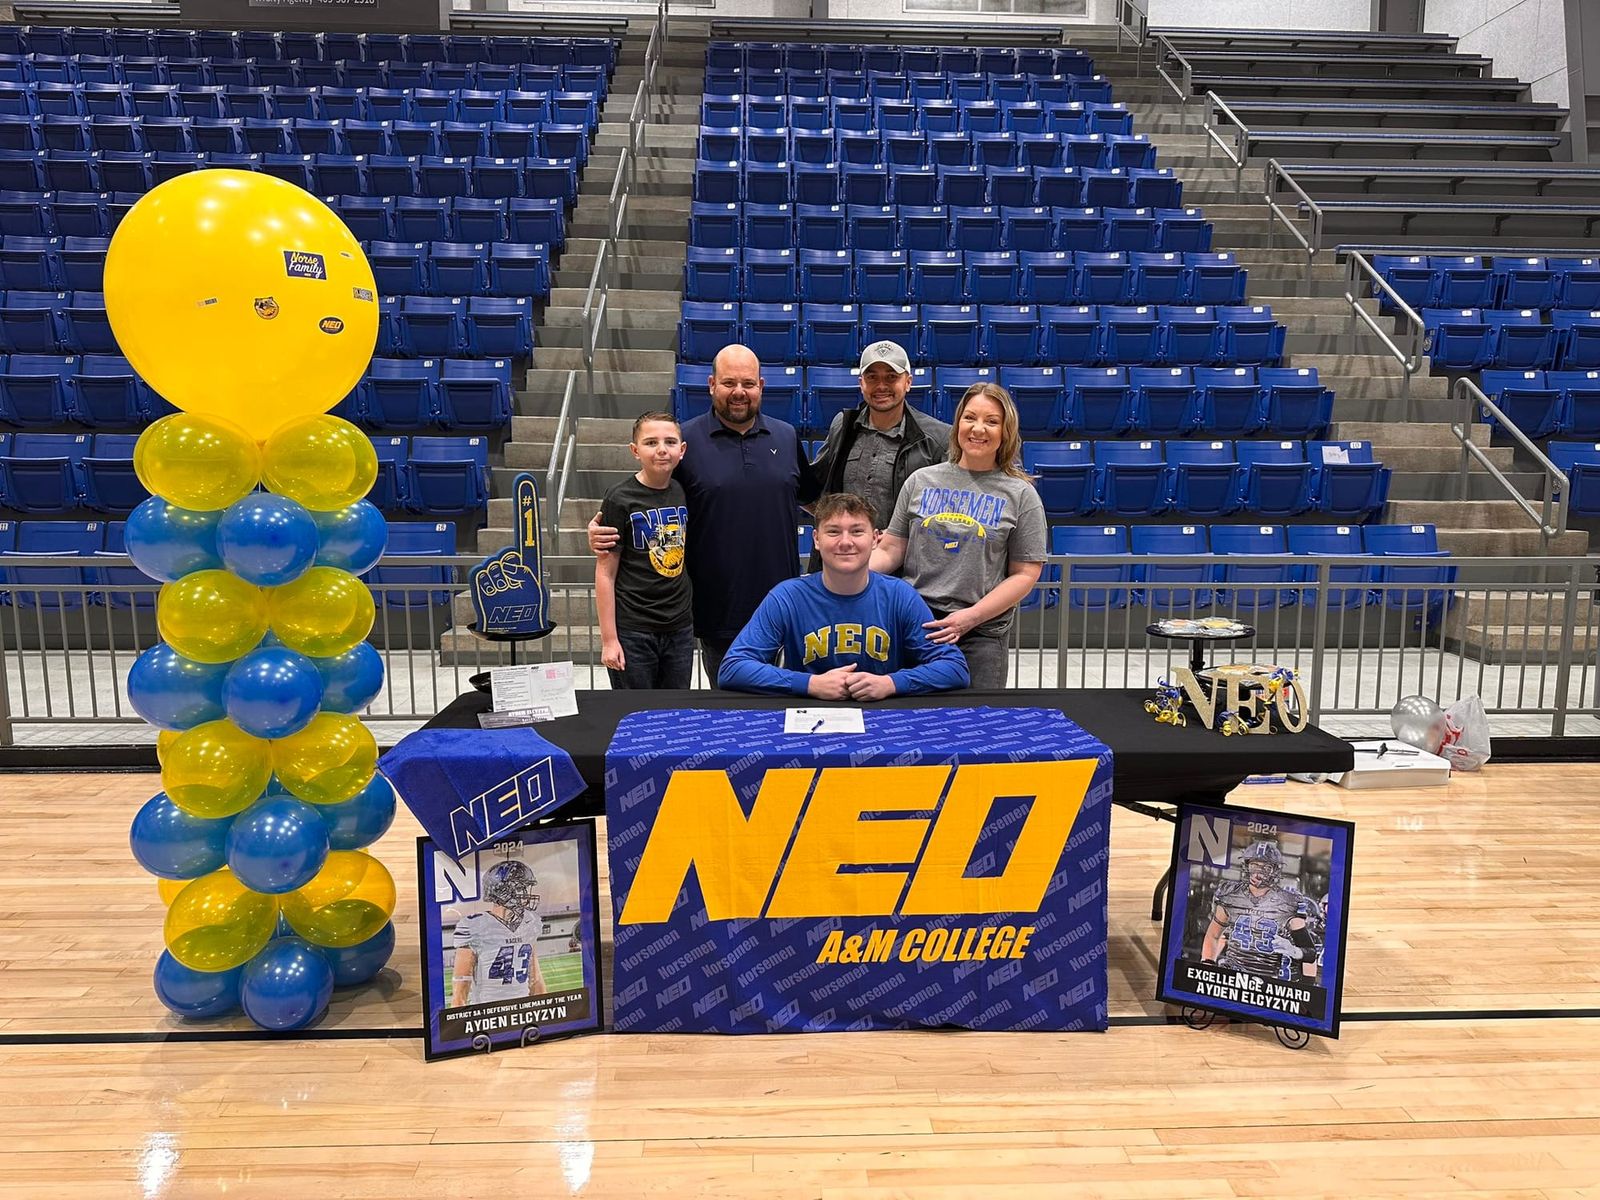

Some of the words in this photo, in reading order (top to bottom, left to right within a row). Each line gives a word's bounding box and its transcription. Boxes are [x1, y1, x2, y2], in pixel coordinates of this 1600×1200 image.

[288, 261, 323, 278] Family
[291, 252, 318, 264] Norse
[321, 320, 342, 329] NEO
[522, 495, 532, 506] #
[918, 488, 1006, 528] NORSEMEN
[524, 508, 535, 547] 1
[488, 604, 538, 624] NEO
[803, 623, 891, 665] NEO
[1170, 667, 1307, 734] NEO
[631, 734, 666, 742] NEO
[666, 736, 701, 744] NEO
[702, 738, 736, 746] NEO
[738, 740, 773, 748] NEO
[774, 741, 810, 752] NEO
[812, 743, 847, 759] NEO
[969, 740, 1022, 755] Norsemen
[1007, 743, 1061, 763] Norsemen
[628, 745, 691, 771] Norsemen
[665, 747, 727, 776] Norsemen
[725, 750, 764, 778] semen
[849, 745, 885, 767] NEO
[450, 756, 556, 856] NEO
[619, 777, 656, 813] NEO
[608, 820, 647, 852] semen
[975, 801, 1030, 844] orsemen
[1247, 821, 1278, 835] 2024
[493, 841, 524, 854] 2024
[618, 758, 1099, 925] NEO
[1187, 814, 1231, 866] N
[433, 850, 478, 902] N
[1068, 878, 1102, 914] NEO
[805, 916, 843, 947] NEO
[815, 929, 899, 963] A&M
[898, 926, 1036, 962] COLLEGE
[1032, 920, 1092, 963] Norsemen
[1231, 914, 1278, 954] 43
[488, 944, 532, 985] 43
[620, 929, 681, 972] Norsemen
[657, 939, 718, 980] Norsemen
[701, 934, 760, 978] Norsemen
[737, 944, 796, 988] Norsemen
[809, 963, 870, 1002] Norsemen
[846, 971, 906, 1011] Norsemen
[986, 959, 1023, 991] NEO
[1022, 967, 1059, 1001] NEO
[1187, 967, 1262, 992] EXCELLENCE
[1265, 983, 1311, 1002] AWARD
[446, 1012, 472, 1021] DISTRICT
[486, 1004, 518, 1015] DEFENSIVE
[519, 999, 546, 1010] LINEMAN
[554, 996, 566, 1004] THE
[567, 993, 583, 1002] YEAR
[614, 976, 648, 1011] NEO
[655, 975, 692, 1010] NEO
[692, 984, 729, 1019] NEO
[729, 992, 765, 1027] NEO
[883, 982, 943, 1018] Norsemen
[1058, 976, 1095, 1010] NEO
[1196, 981, 1239, 1001] AYDEN
[1241, 990, 1300, 1014] ELCYZYN
[465, 1015, 508, 1034] AYDEN
[510, 1005, 567, 1026] ELCYZYN
[765, 998, 800, 1033] NEO
[801, 1007, 837, 1032] NEO
